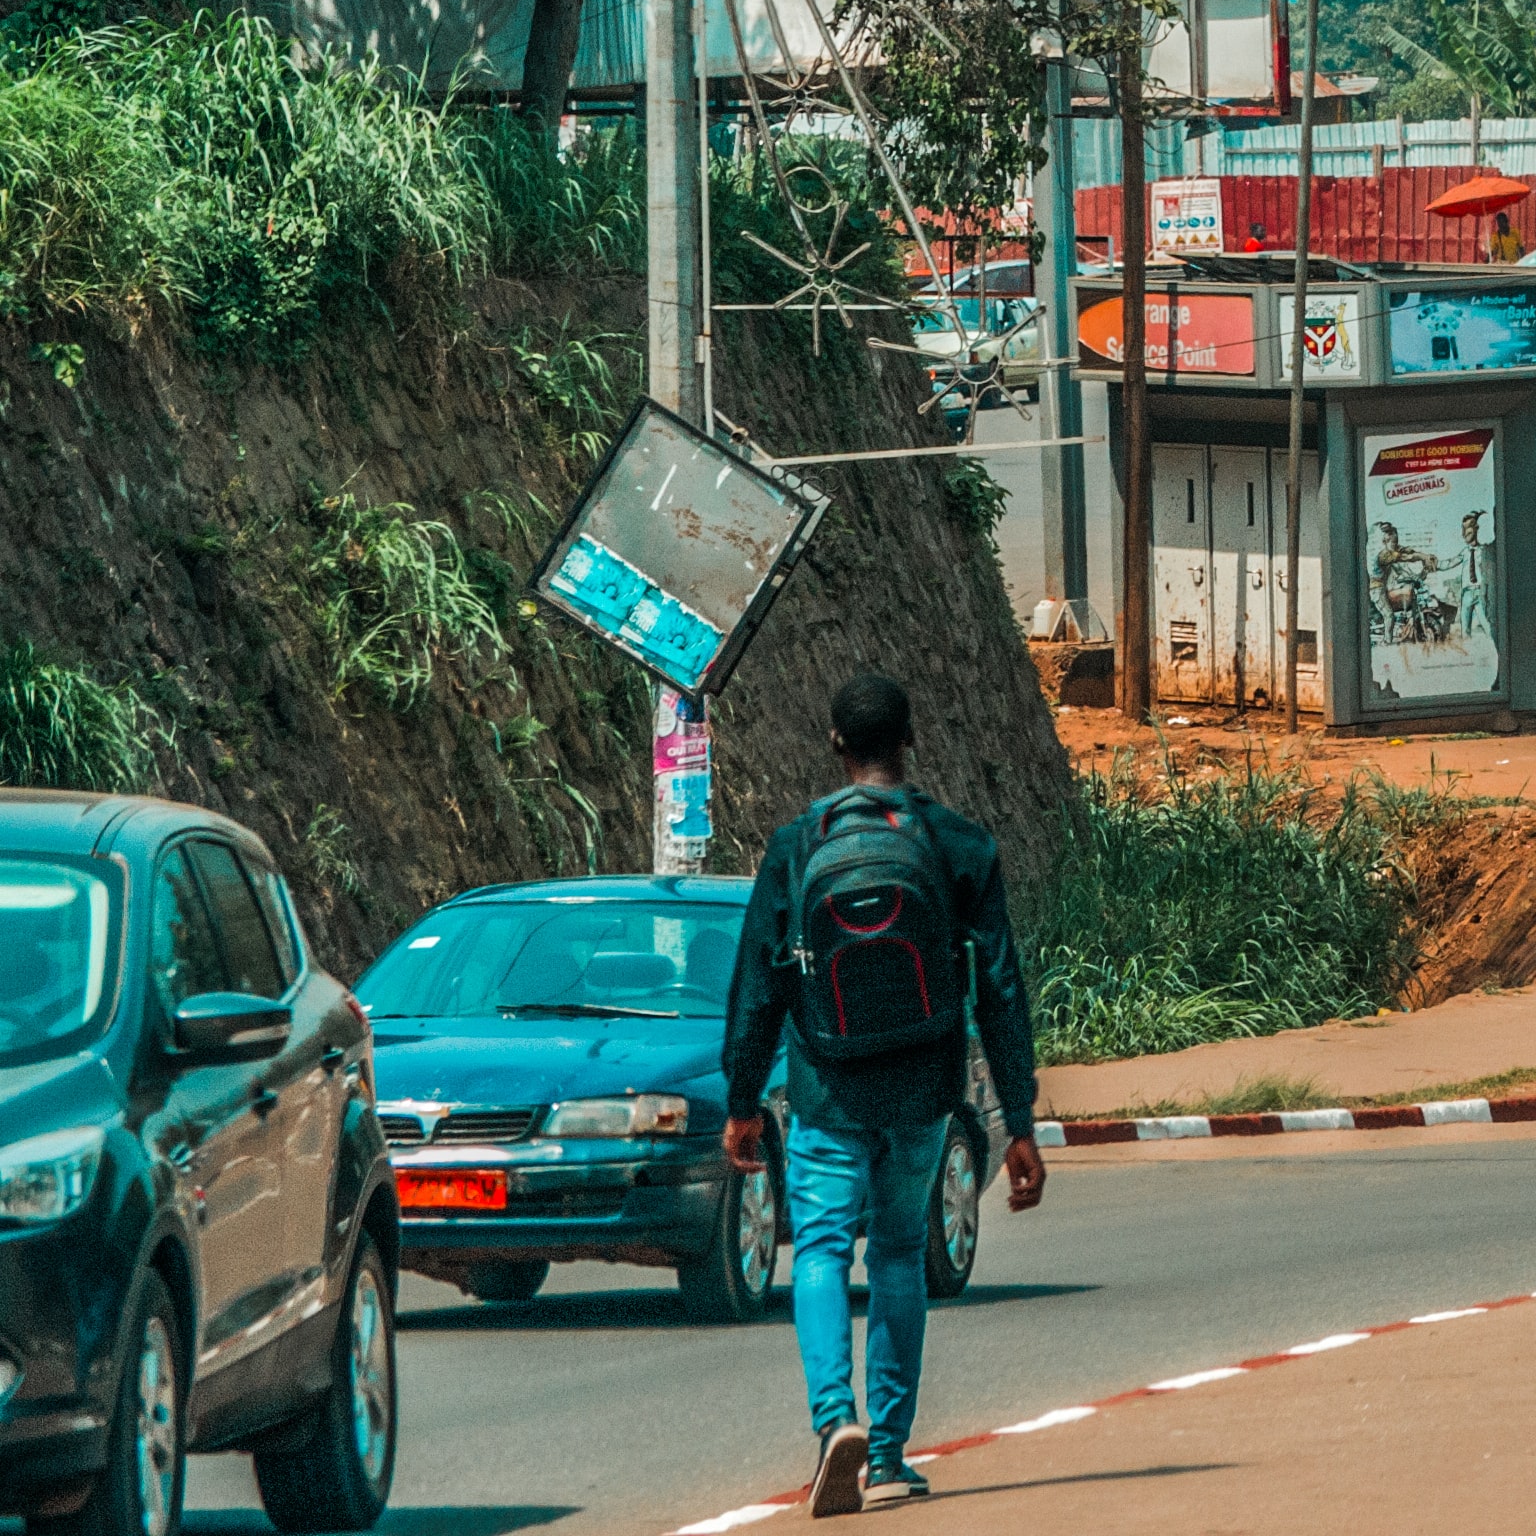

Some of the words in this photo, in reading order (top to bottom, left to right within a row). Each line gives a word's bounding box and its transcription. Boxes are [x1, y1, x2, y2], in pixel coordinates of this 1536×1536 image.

[1144, 303, 1191, 331] range
[1106, 336, 1168, 365] Seice
[1172, 339, 1217, 368] Point
[1380, 449, 1414, 460] BONJOUR
[1416, 447, 1425, 457] ET
[1427, 446, 1448, 456] GOOD
[1449, 444, 1484, 455] MORNING
[1386, 477, 1445, 499] CAMEROUNAIS
